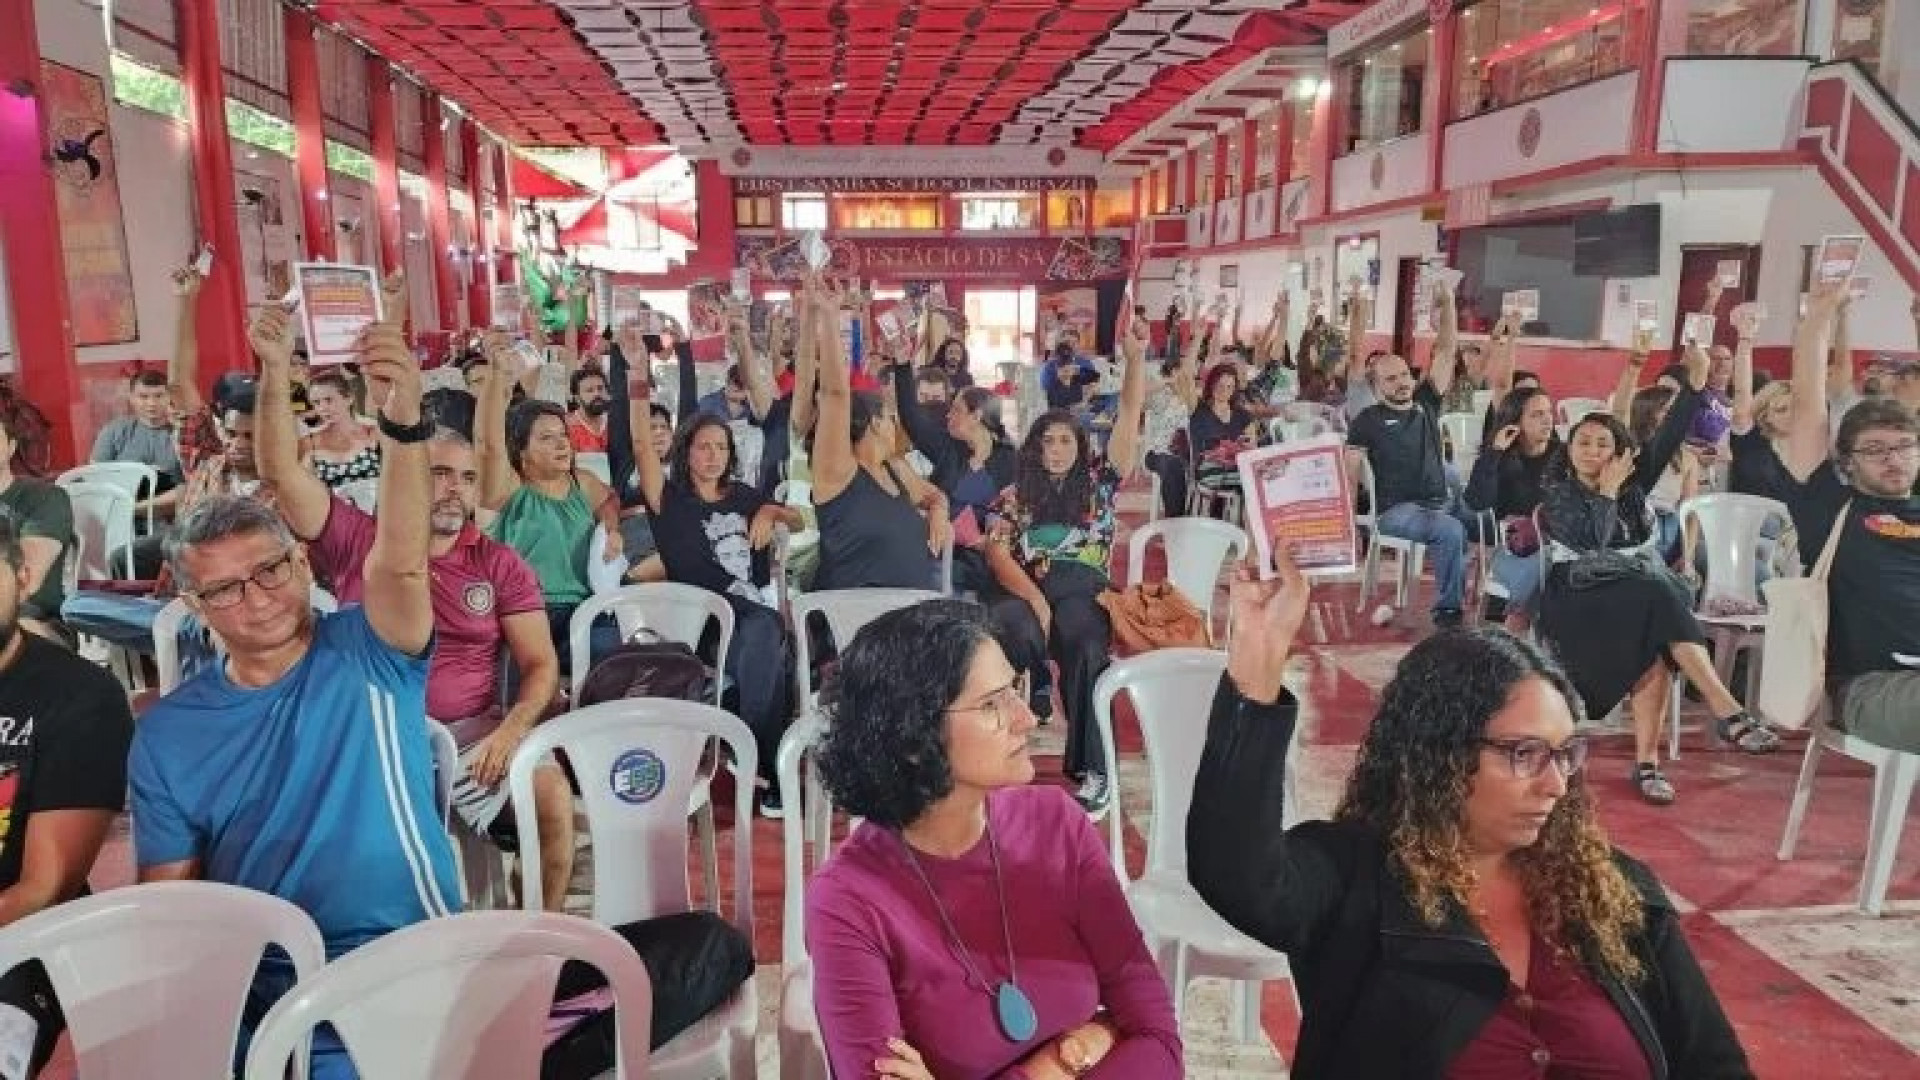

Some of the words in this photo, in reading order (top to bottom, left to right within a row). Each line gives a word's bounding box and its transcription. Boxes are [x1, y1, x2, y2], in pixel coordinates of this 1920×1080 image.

[738, 179, 796, 191] FIRST
[803, 179, 880, 191] SAMBA
[885, 179, 975, 191] SCHOOL
[984, 179, 1009, 191] IN
[978, 246, 1011, 266] DE
